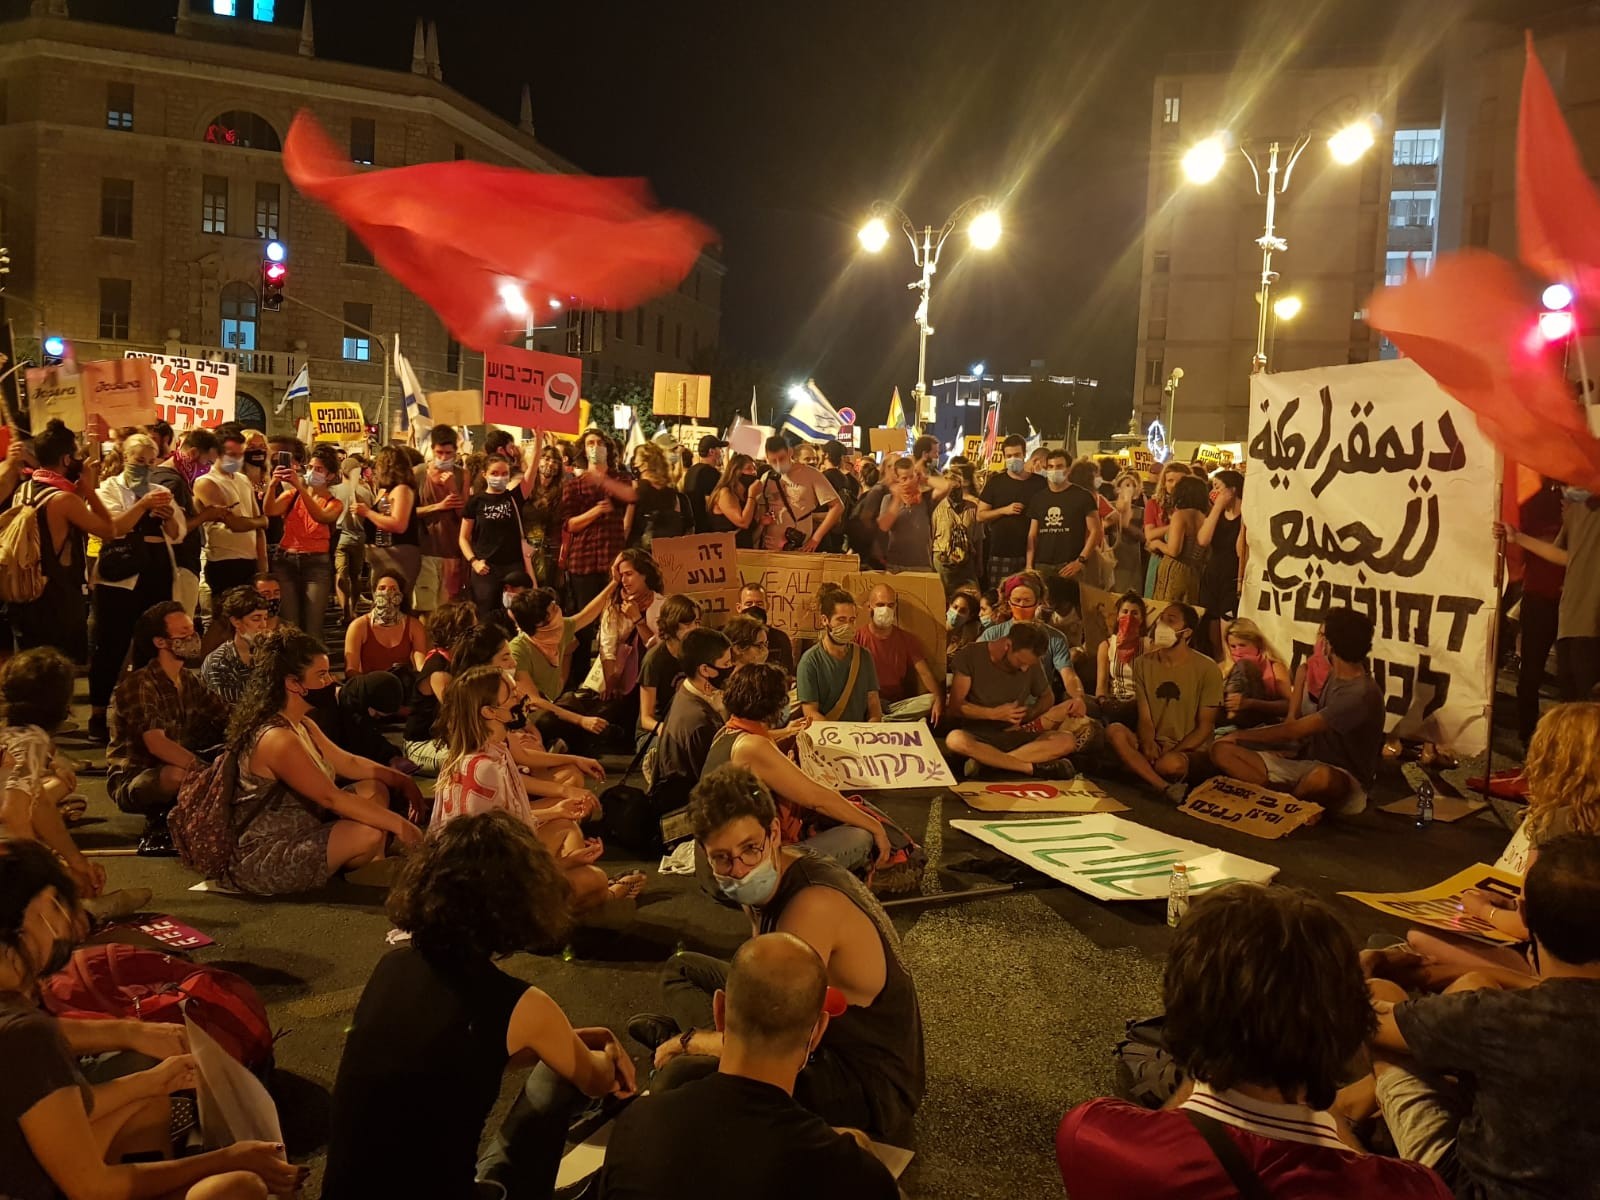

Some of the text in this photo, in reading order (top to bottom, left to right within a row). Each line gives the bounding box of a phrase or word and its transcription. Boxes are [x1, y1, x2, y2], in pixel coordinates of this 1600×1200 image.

[487, 361, 545, 387] הכיבוש
[1249, 385, 1467, 499] ديمقراطية
[697, 543, 723, 561] זה
[1267, 494, 1440, 590] للجميع
[687, 566, 727, 585] נוגע
[817, 726, 923, 750] מהפכה של
[833, 753, 926, 785] תקווה
